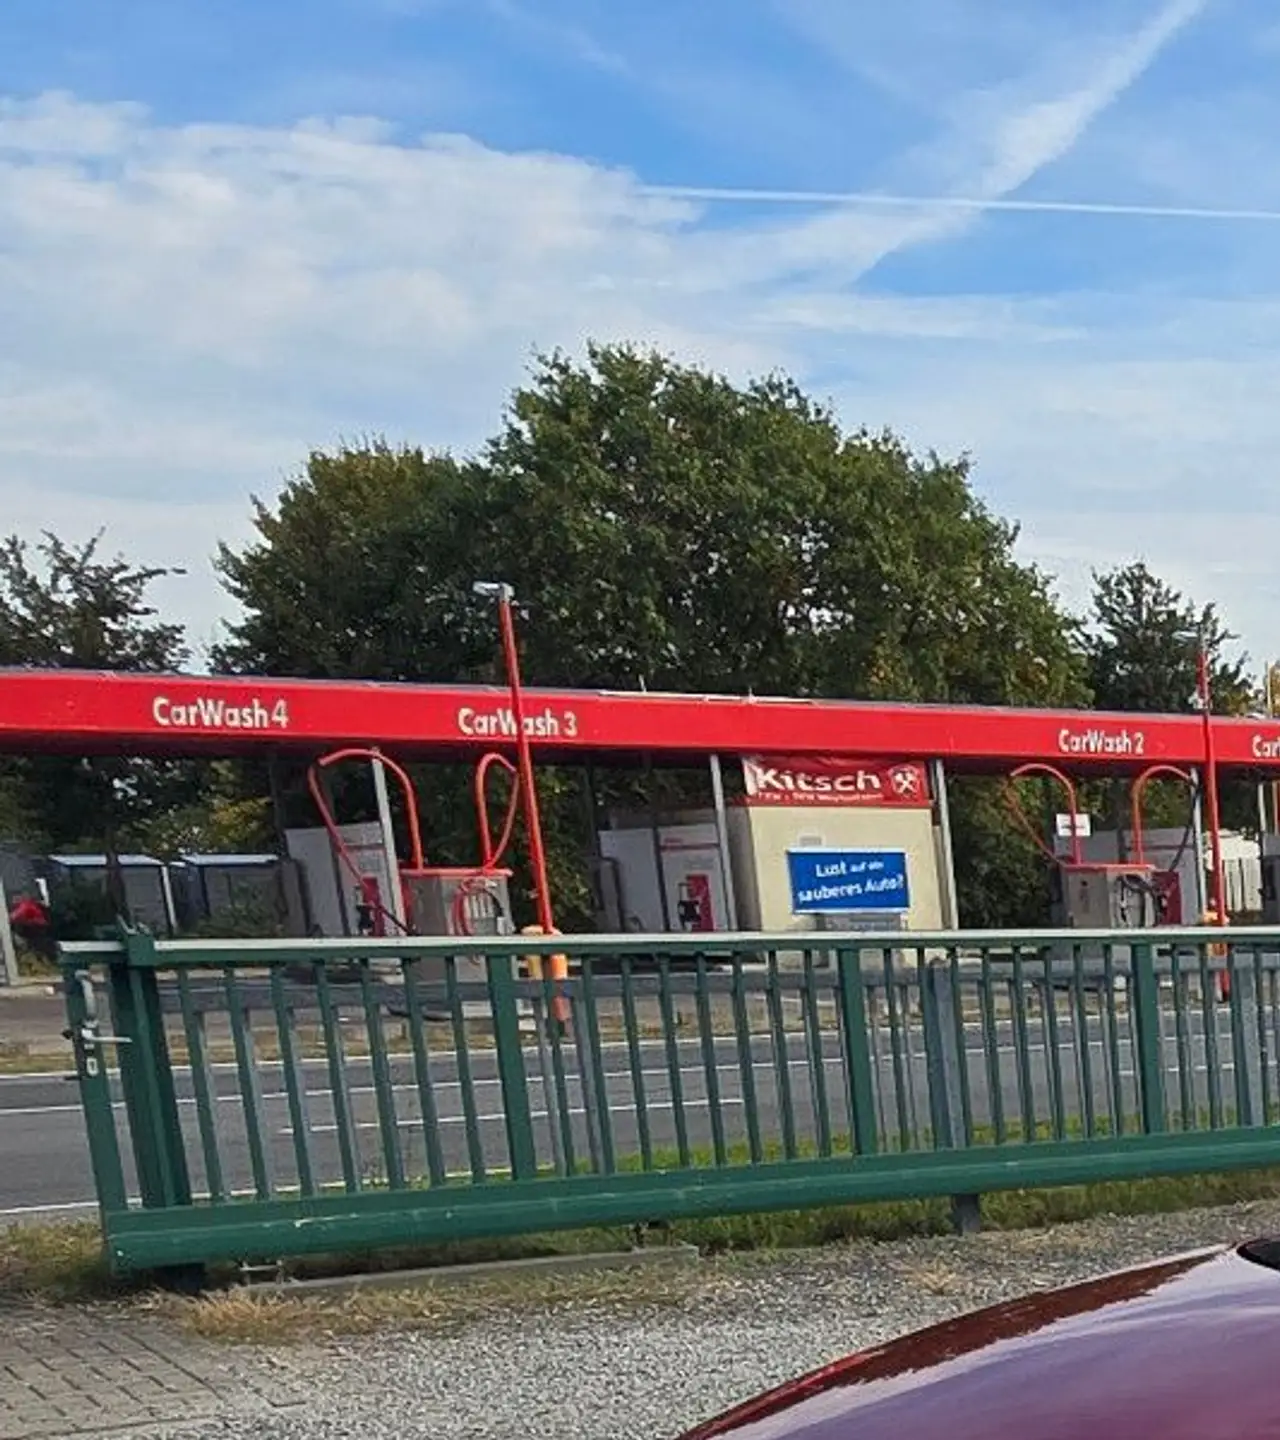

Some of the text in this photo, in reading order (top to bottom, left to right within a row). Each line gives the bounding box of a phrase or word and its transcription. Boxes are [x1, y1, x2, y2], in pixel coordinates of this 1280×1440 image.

[152, 696, 289, 729] CarWash 4
[458, 707, 578, 737] CarWash 3
[1058, 728, 1145, 755] CarWash 2
[756, 768, 882, 792] Kitsch
[815, 860, 847, 878] Lust
[797, 873, 904, 903] sauberes Auto?
